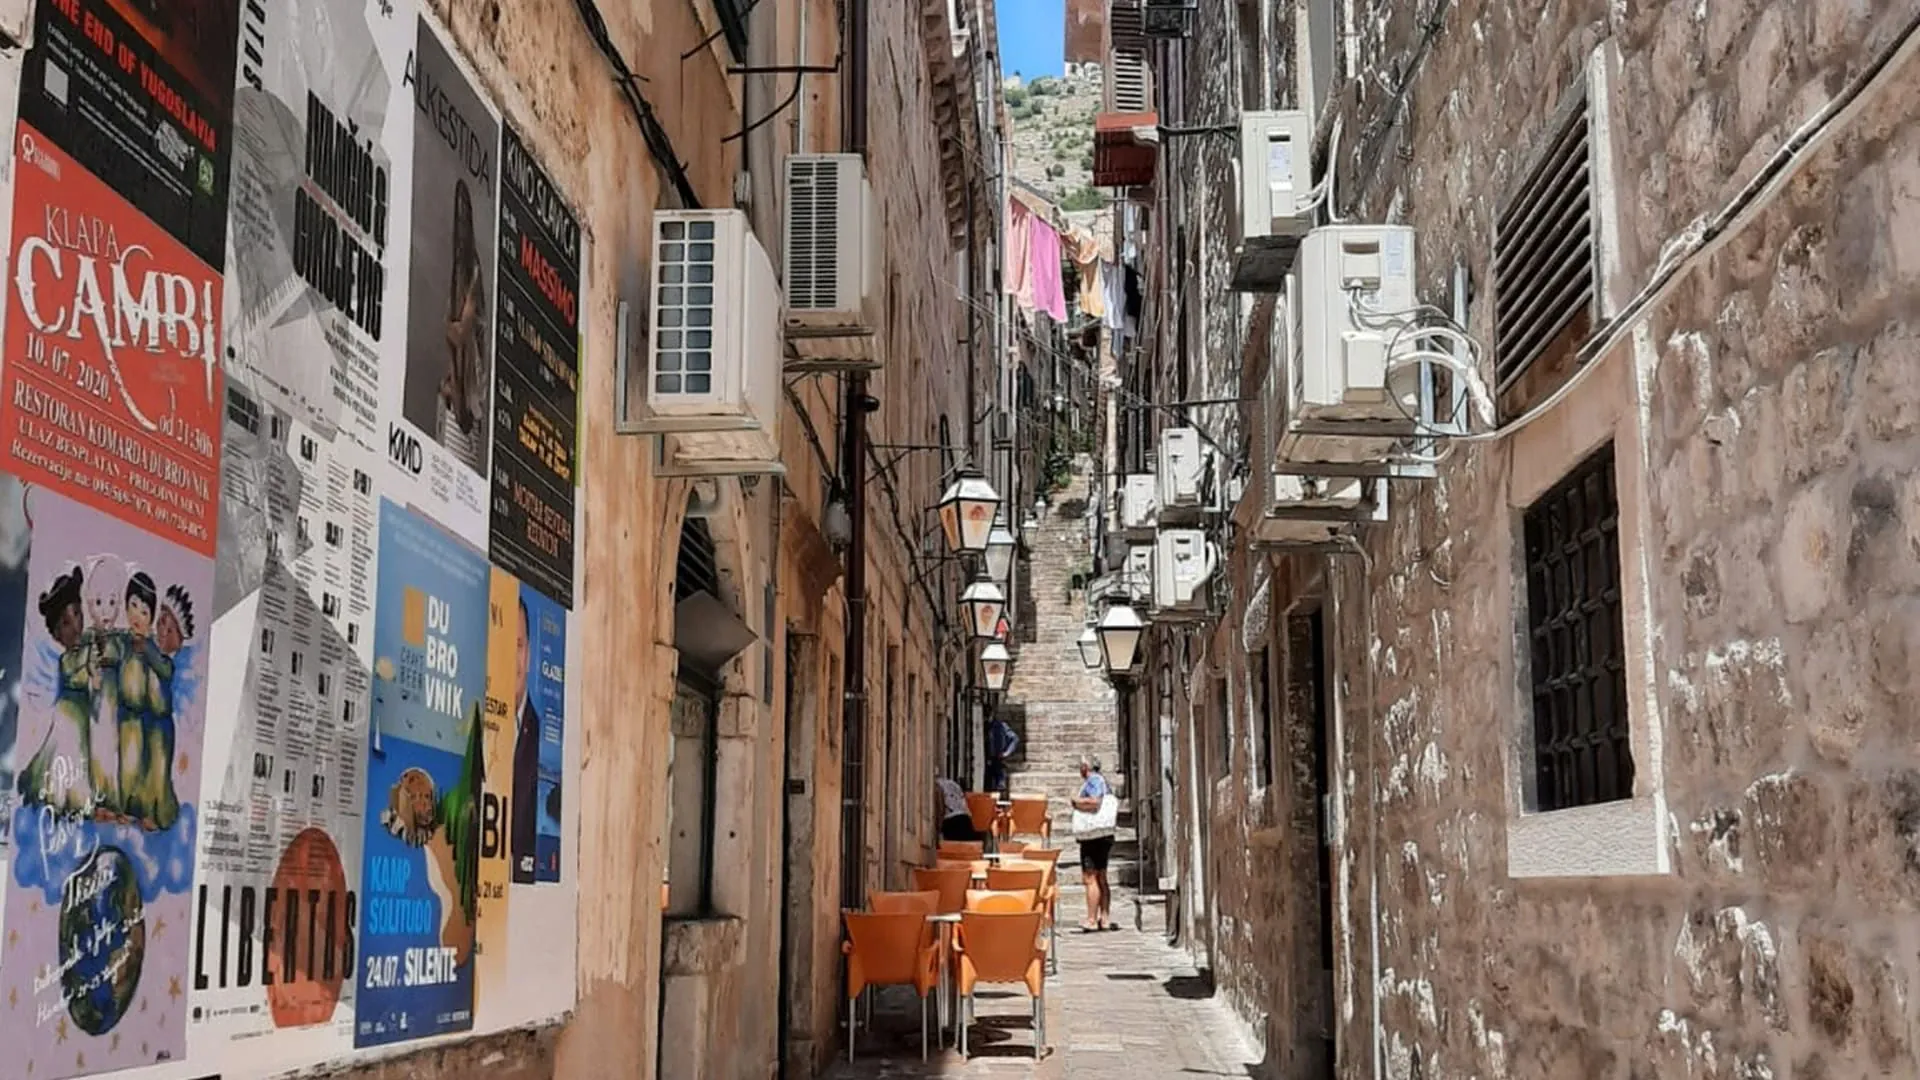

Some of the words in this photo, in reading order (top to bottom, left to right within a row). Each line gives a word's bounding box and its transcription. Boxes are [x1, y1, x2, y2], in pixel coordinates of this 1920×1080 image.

[51, 0, 80, 26] HE
[83, 11, 115, 57] END
[117, 42, 138, 75] OF
[140, 61, 217, 152] YUGOSLAVIA
[403, 49, 491, 198] ALKESTIDA
[506, 137, 535, 206] KINO
[45, 203, 120, 260] KLAPA
[520, 232, 576, 328] MASSIMO
[15, 236, 217, 412] CAMBI
[26, 332, 48, 366] 10.
[51, 349, 73, 381] 07.
[76, 359, 112, 402] 2020.
[14, 379, 86, 445] RESTORAN
[87, 417, 148, 470] KOMARDA
[148, 449, 210, 501] DUBROVNIK
[389, 421, 423, 474] KMD
[428, 595, 449, 634] DU
[426, 634, 458, 679] BRO
[425, 673, 464, 719] VNIK
[370, 855, 411, 893] KAMP
[194, 884, 357, 991] LIBERTAS
[368, 896, 432, 935] SOLITUDO
[365, 955, 400, 989] 24.07.
[404, 946, 458, 988] SILENTE
